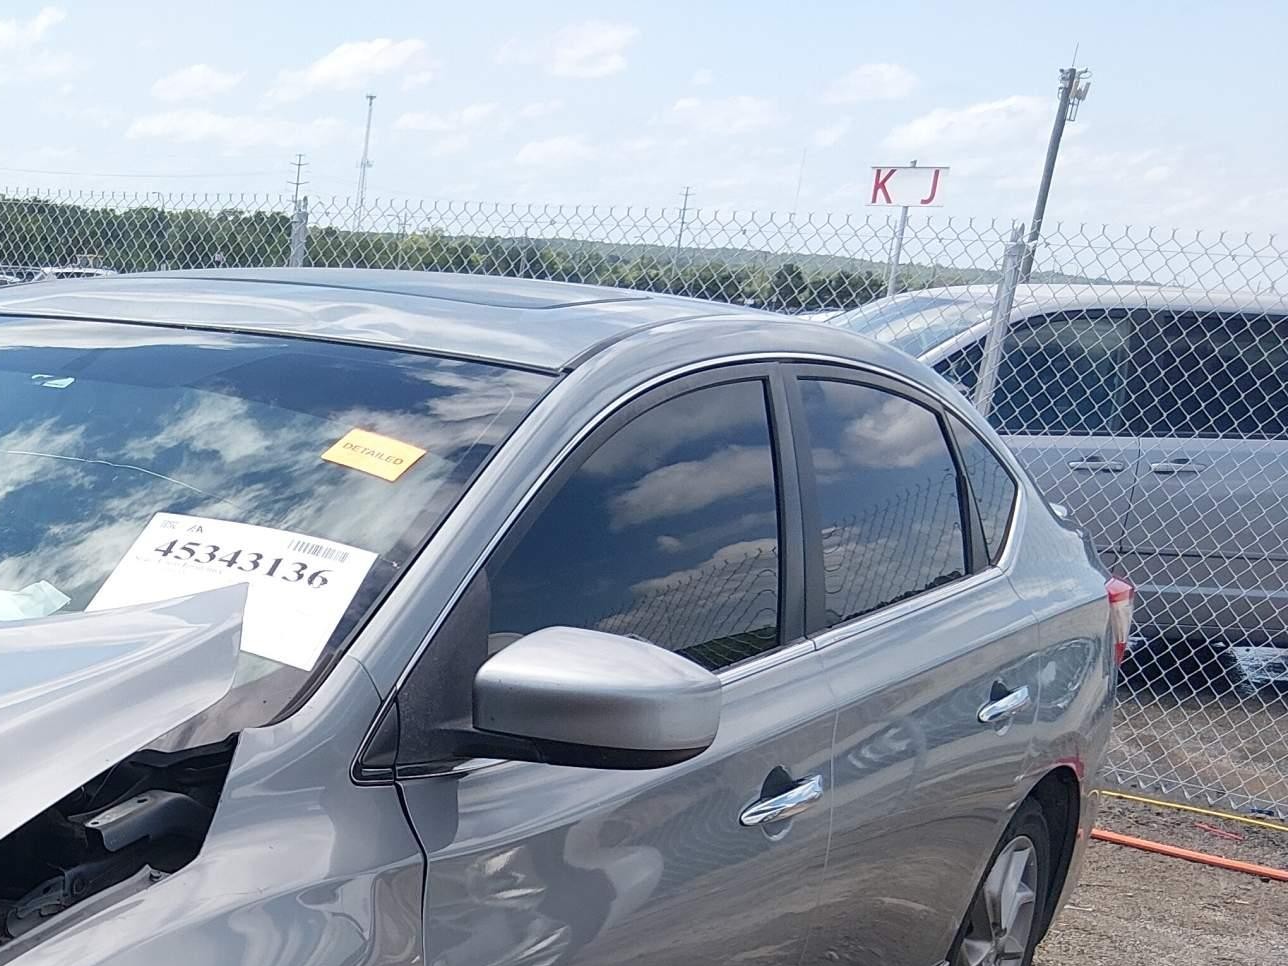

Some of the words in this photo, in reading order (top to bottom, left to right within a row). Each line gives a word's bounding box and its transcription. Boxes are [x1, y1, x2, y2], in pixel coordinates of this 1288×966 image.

[871, 168, 897, 204] K
[920, 168, 940, 205] J
[342, 441, 405, 466] DETAILED
[153, 539, 333, 589] 45343136
